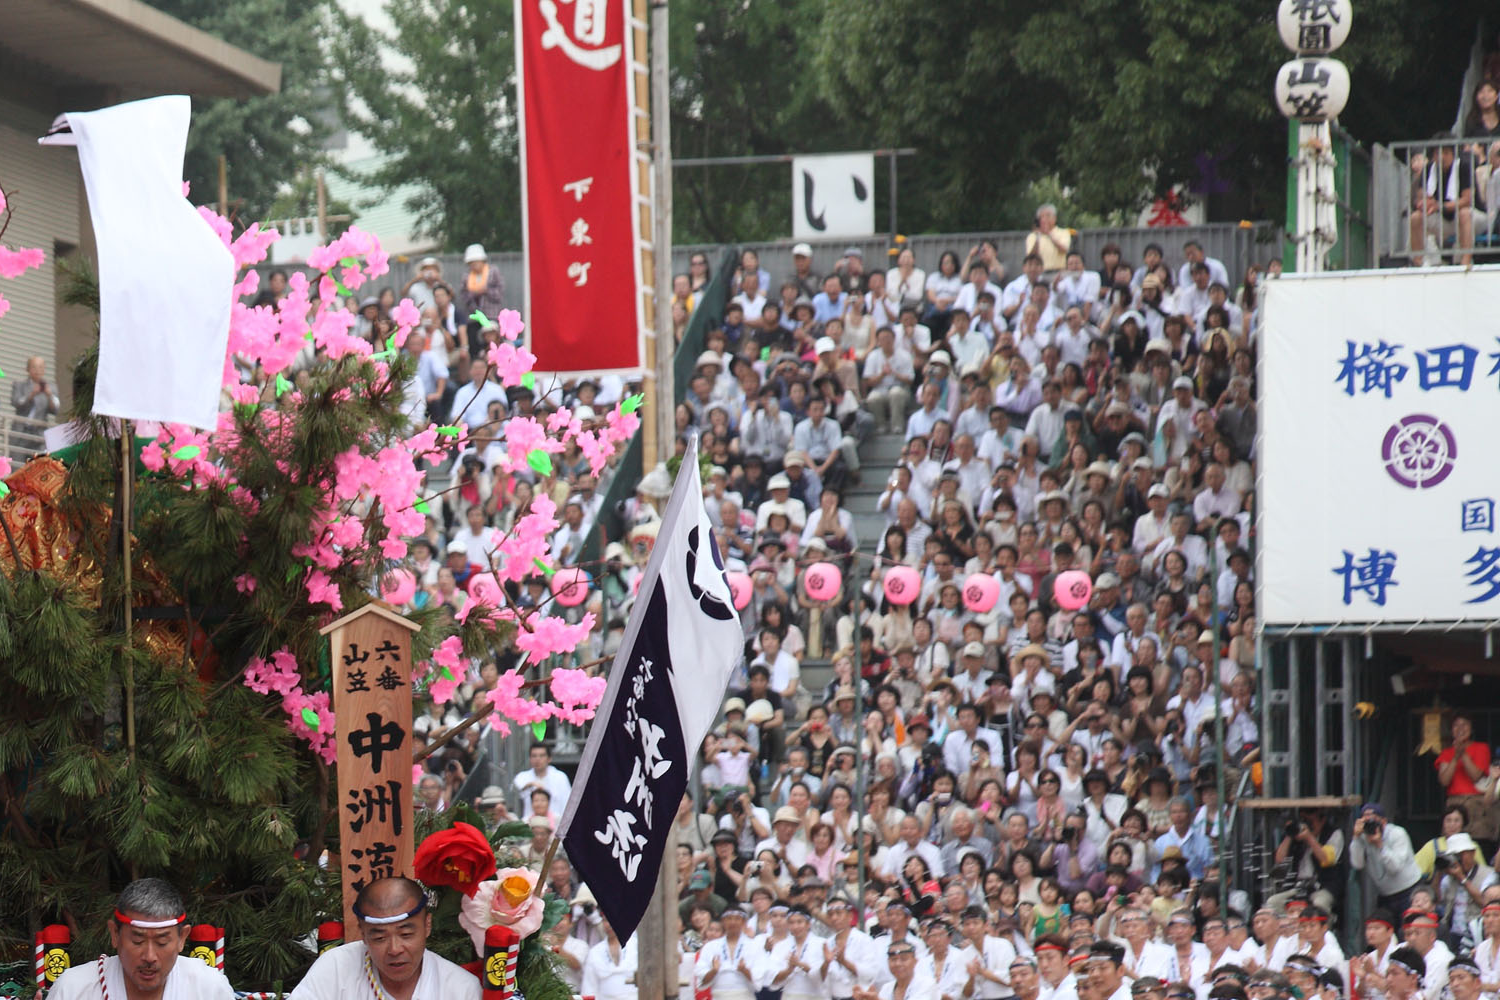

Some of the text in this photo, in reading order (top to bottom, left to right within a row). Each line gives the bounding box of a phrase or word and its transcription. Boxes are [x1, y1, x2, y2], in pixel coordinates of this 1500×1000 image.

[802, 167, 869, 232] い
[1334, 334, 1500, 399] 櫛田
[342, 643, 371, 694] 山笠
[373, 640, 406, 692] 六番
[346, 711, 406, 893] 中洲流
